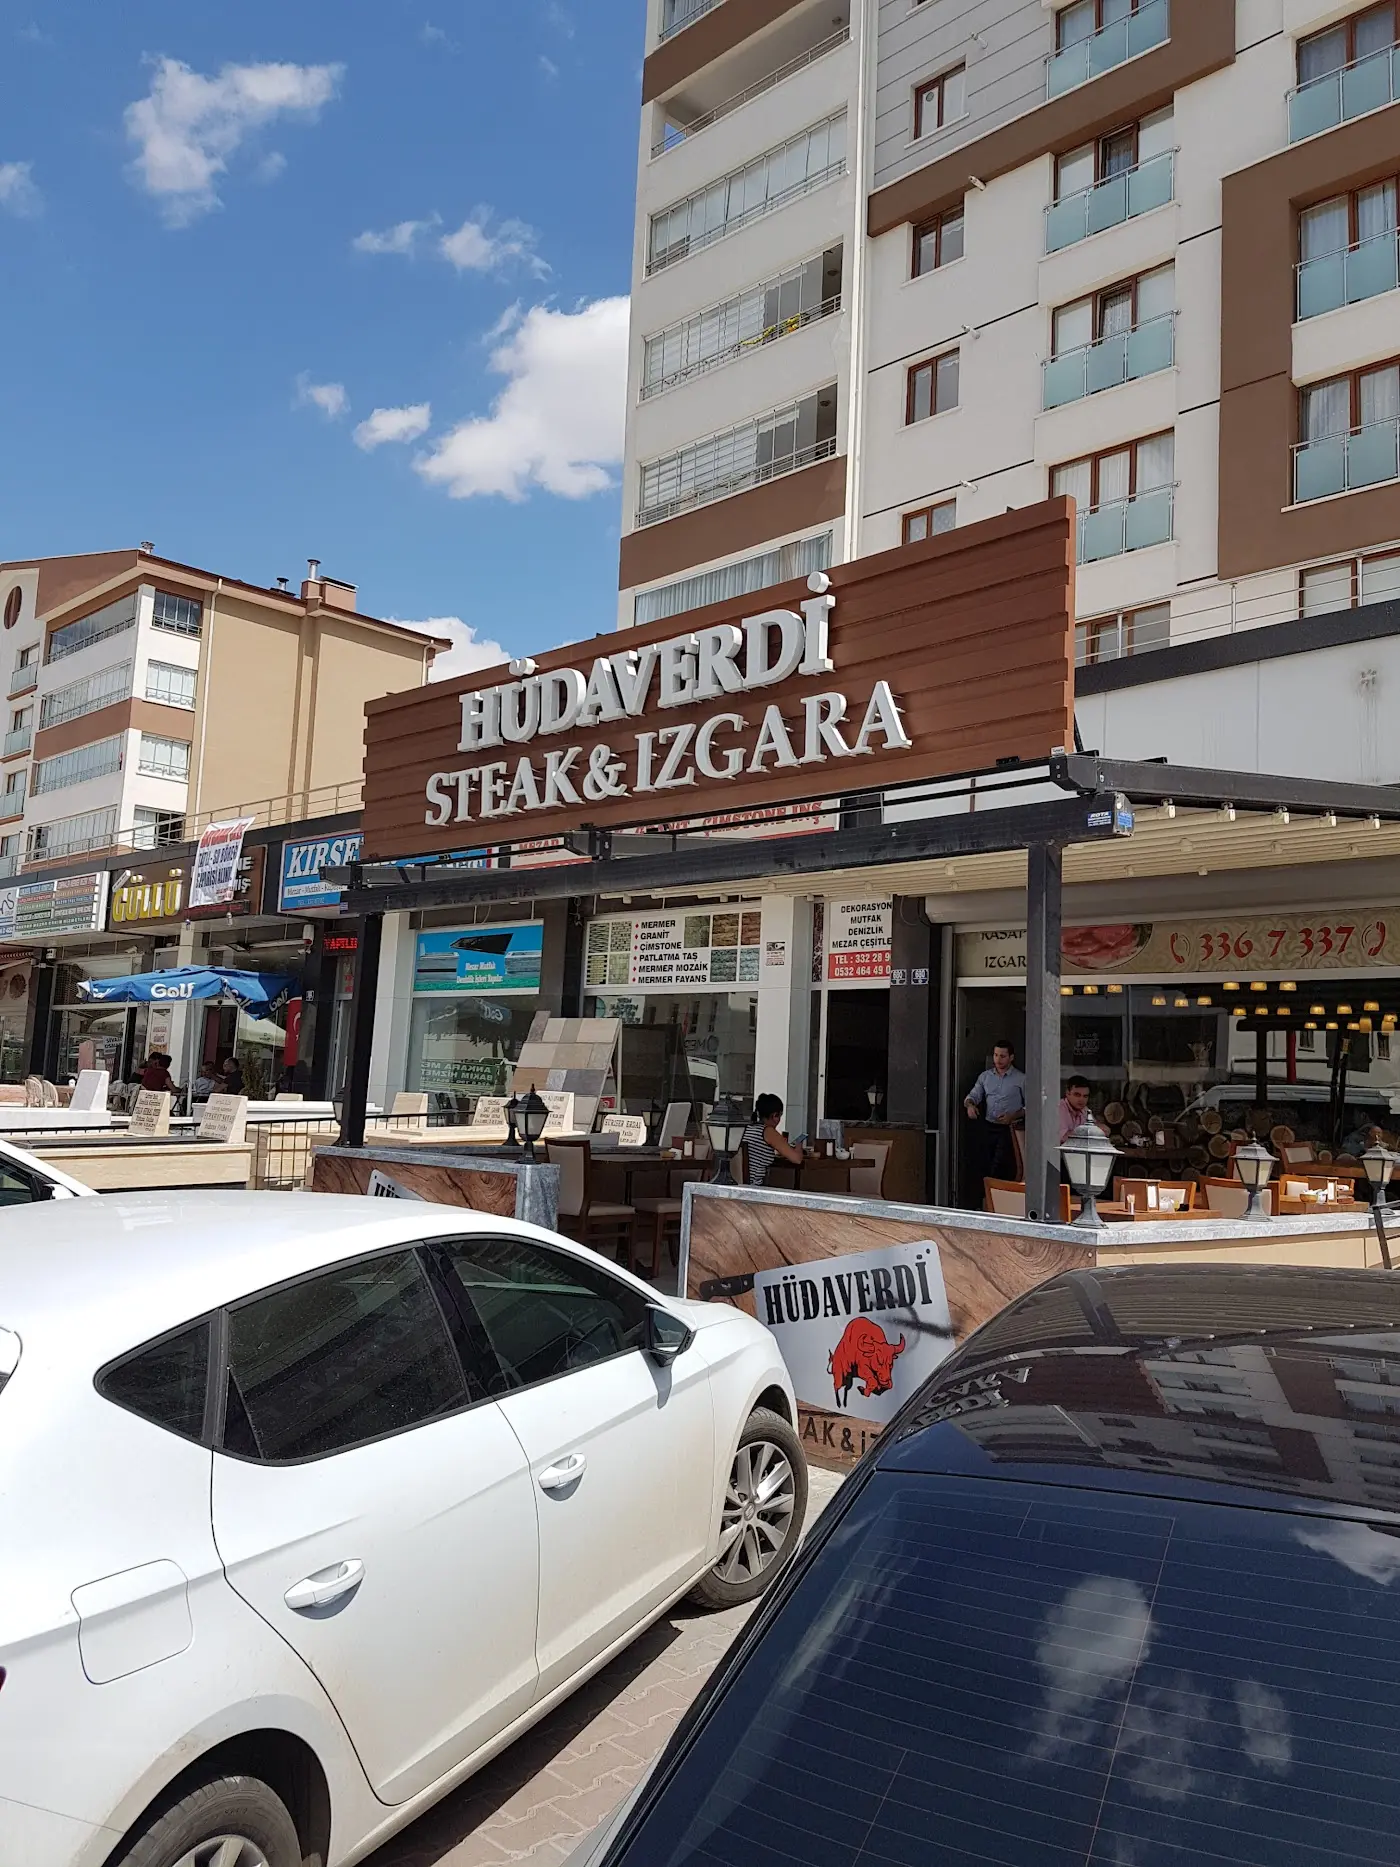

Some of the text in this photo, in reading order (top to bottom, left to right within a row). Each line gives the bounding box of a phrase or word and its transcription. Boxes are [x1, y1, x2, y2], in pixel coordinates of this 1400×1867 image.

[457, 571, 836, 752] HÜDAVERDİ
[633, 680, 913, 793] IZGARA
[112, 868, 183, 922] GÜLLÜ
[840, 901, 892, 914] DEKORASYON
[640, 919, 676, 929] MERMER
[850, 914, 882, 925] MUTFAK
[640, 929, 670, 940] GRANİT
[832, 934, 893, 949] MEZAR ÇEŞİTLE
[639, 941, 682, 953] ÇİMSTONE
[1200, 926, 1355, 962] 336 7 337
[639, 952, 698, 962] PATLATMA TAŞ
[835, 954, 849, 965] TEL
[855, 952, 870, 963] 332
[872, 951, 883, 962] 28
[884, 951, 891, 961] 9
[984, 955, 1027, 969] IZGAR
[638, 961, 709, 973] MERMER MOZAİK
[834, 963, 892, 977] 0532 464 49 0
[638, 974, 708, 984] MERMER FAYANS
[150, 982, 197, 999] Golf
[268, 987, 289, 1012] Golf
[763, 1254, 933, 1325] HÜDAVERDİ
